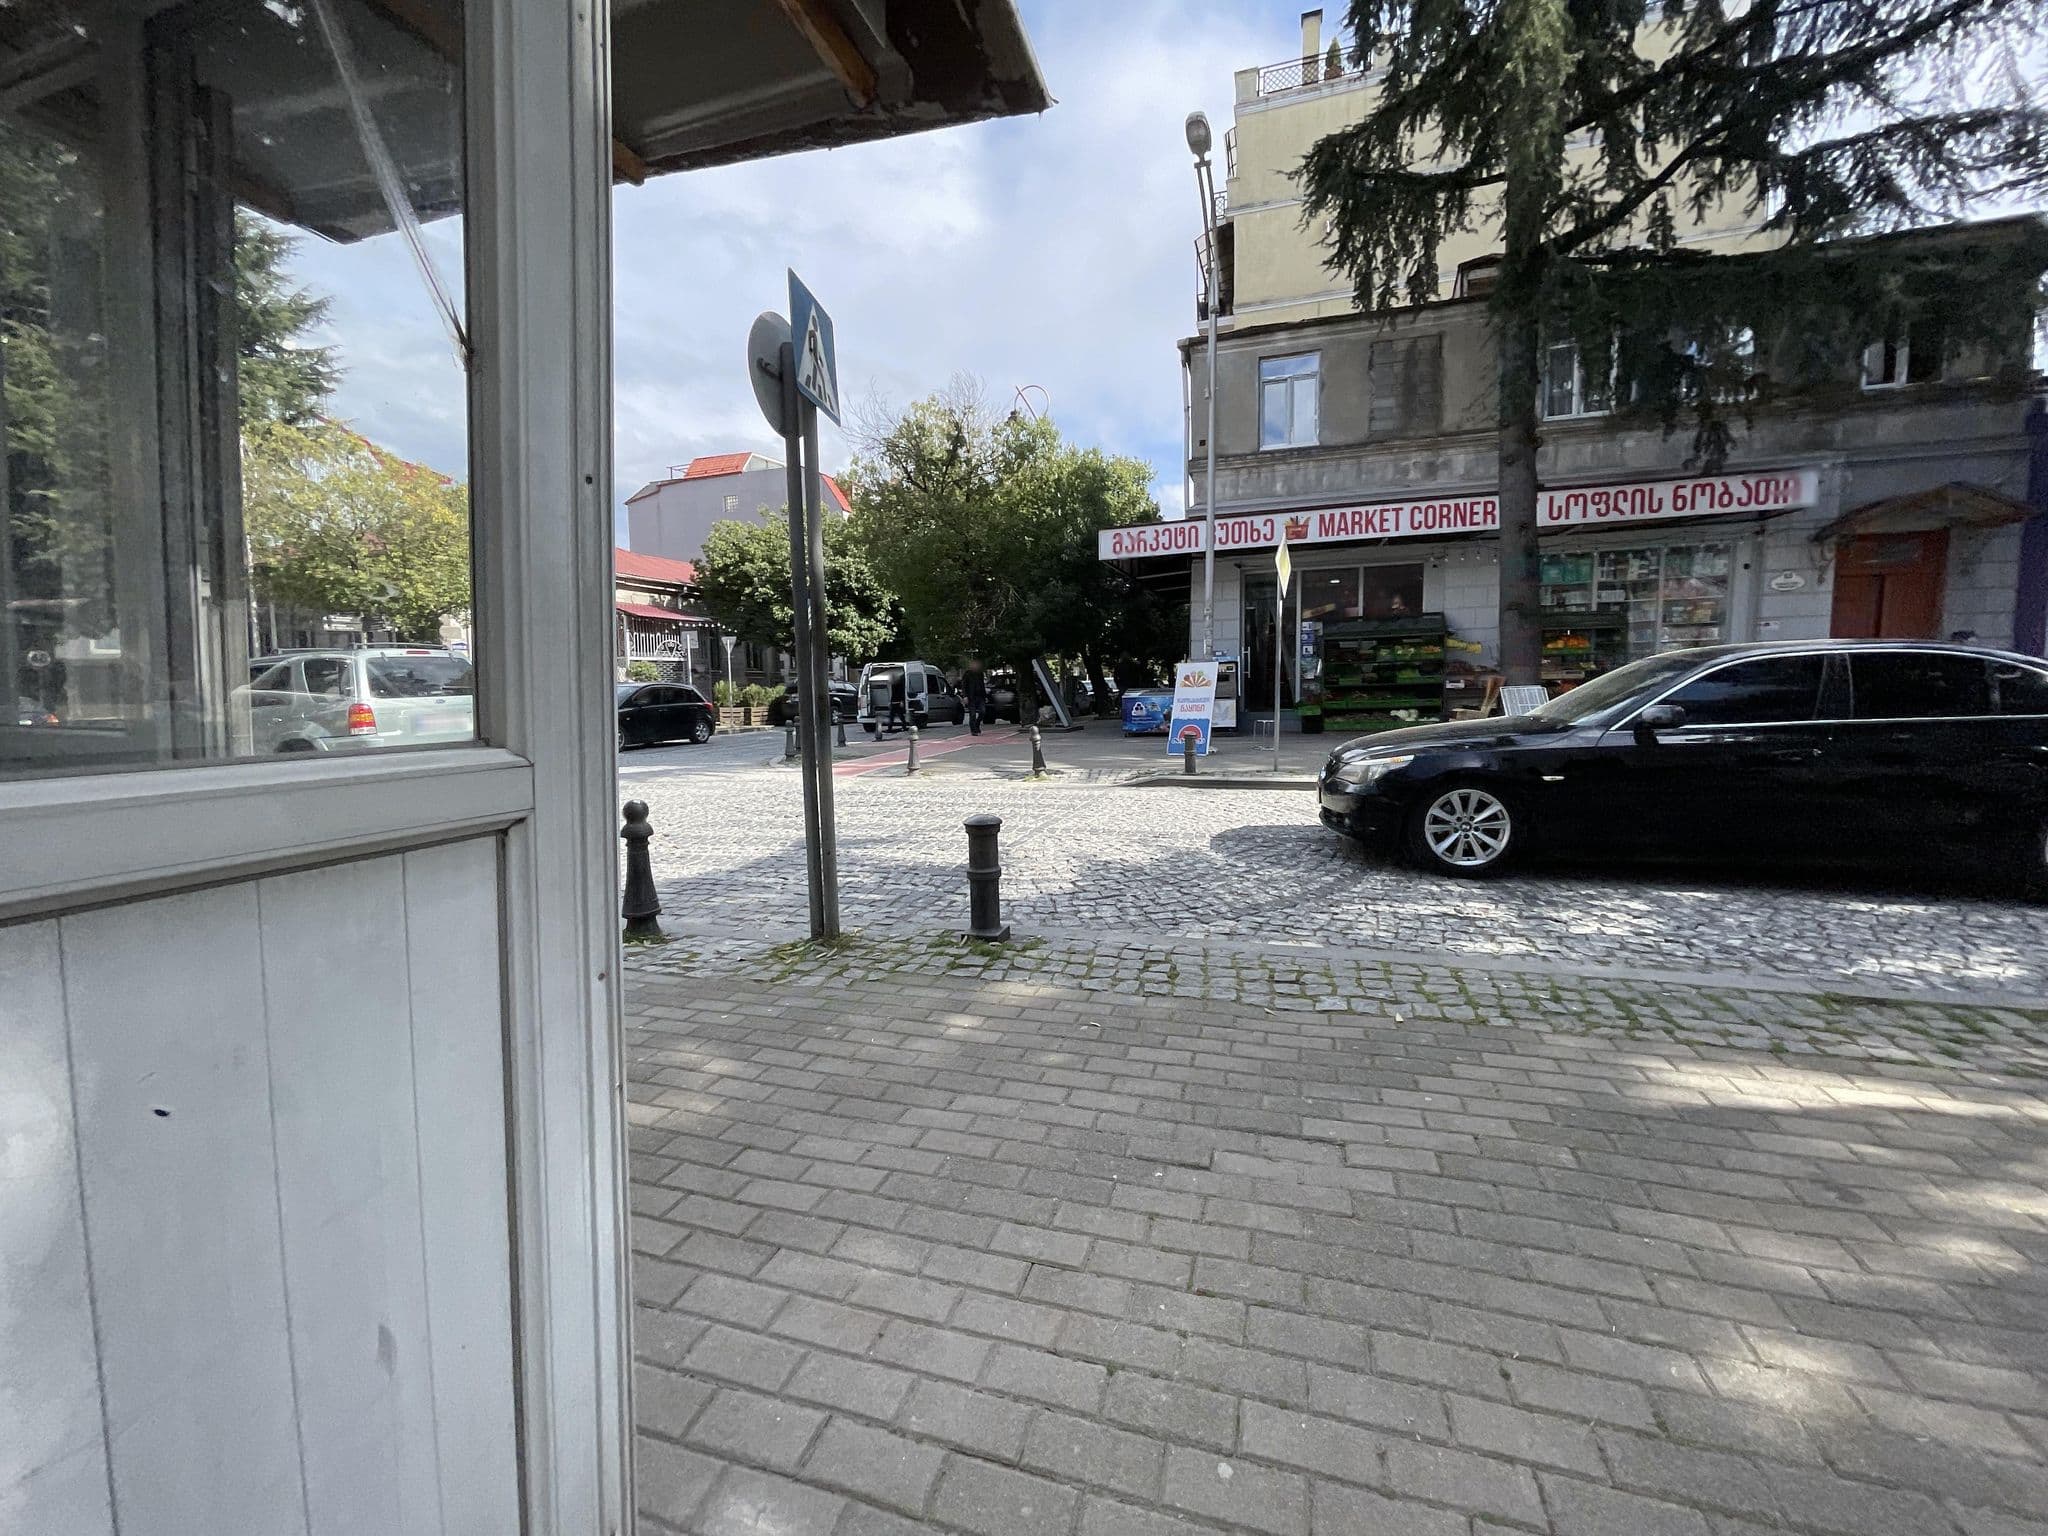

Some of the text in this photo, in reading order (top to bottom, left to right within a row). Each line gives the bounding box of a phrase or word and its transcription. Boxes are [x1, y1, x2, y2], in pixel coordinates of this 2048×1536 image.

[1318, 500, 1496, 538] MARKET CORNER
[1548, 487, 1663, 521] სოფლის
[1112, 525, 1199, 555] მარკეტი
